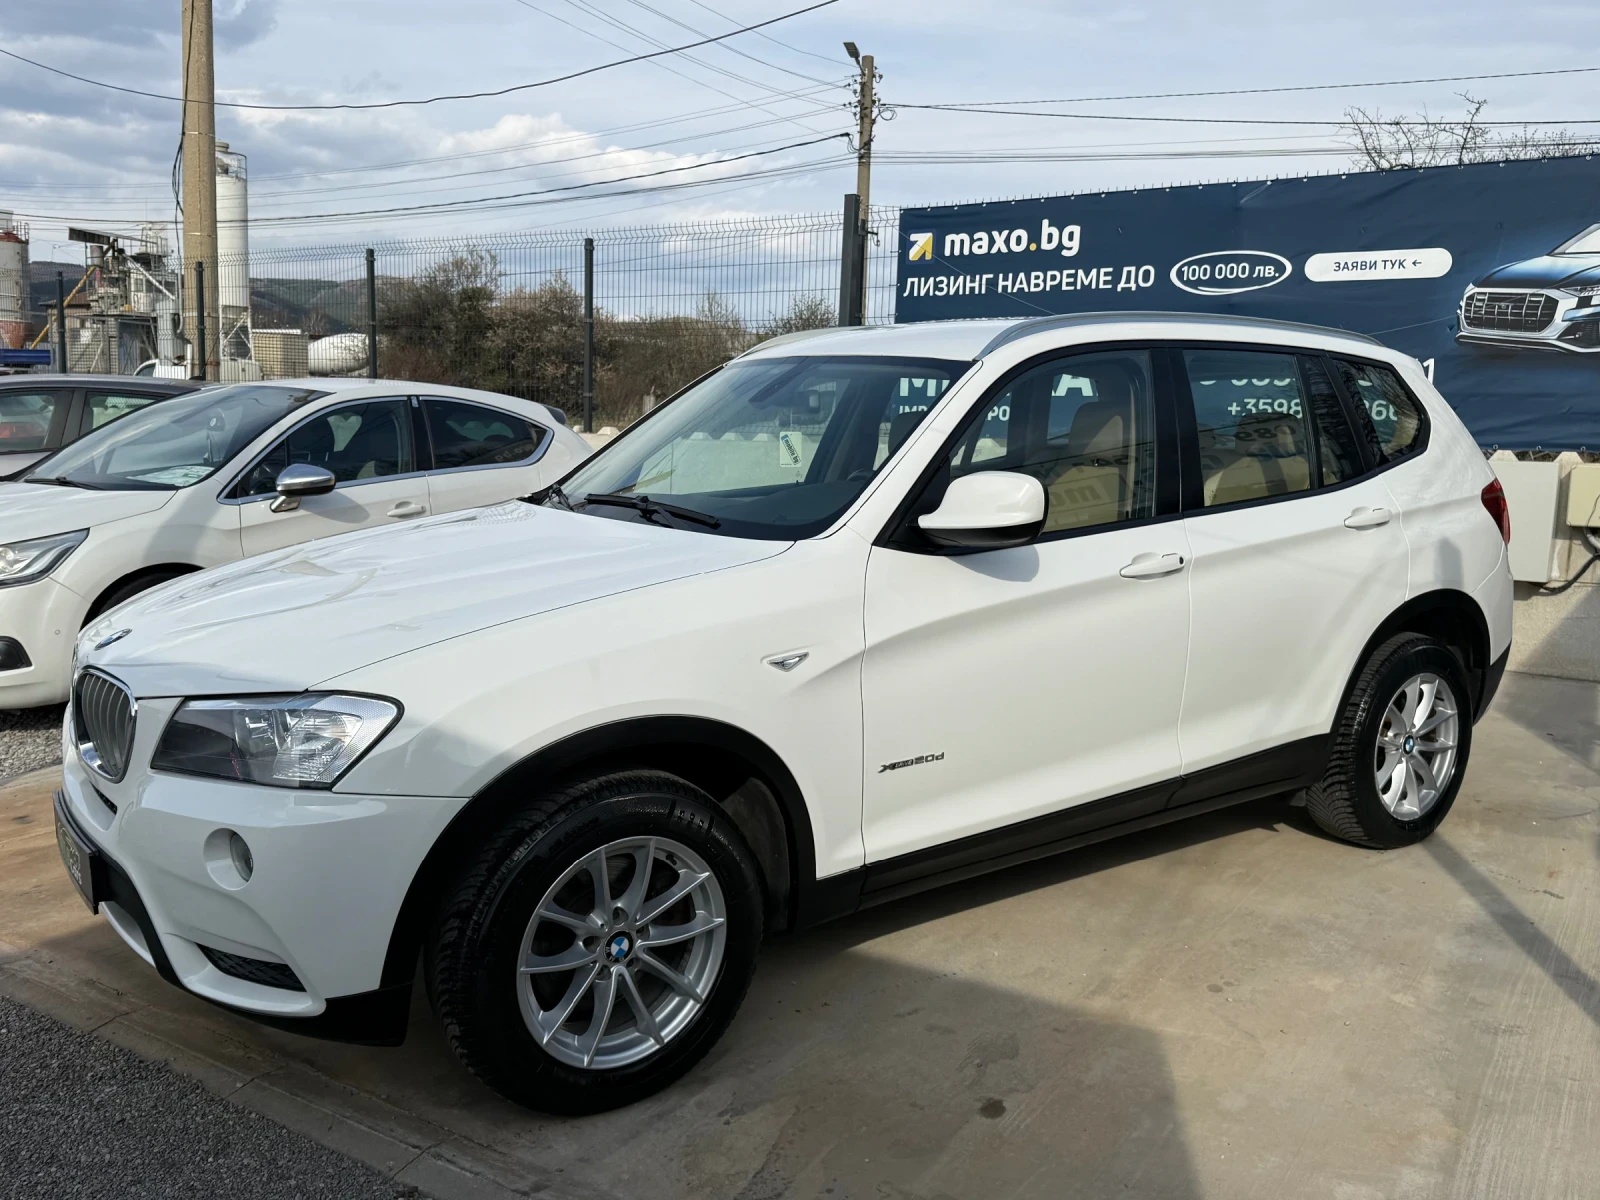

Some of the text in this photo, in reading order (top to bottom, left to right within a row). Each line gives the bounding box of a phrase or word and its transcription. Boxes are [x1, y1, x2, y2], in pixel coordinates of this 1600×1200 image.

[944, 219, 1081, 257] maxo.bg
[1181, 263, 1280, 280] 100 000 лв.
[1333, 259, 1407, 272] ЗАЯВИ ТУК
[903, 265, 1155, 297] ЛИЗИНГ НАВРЕМЕ ДО
